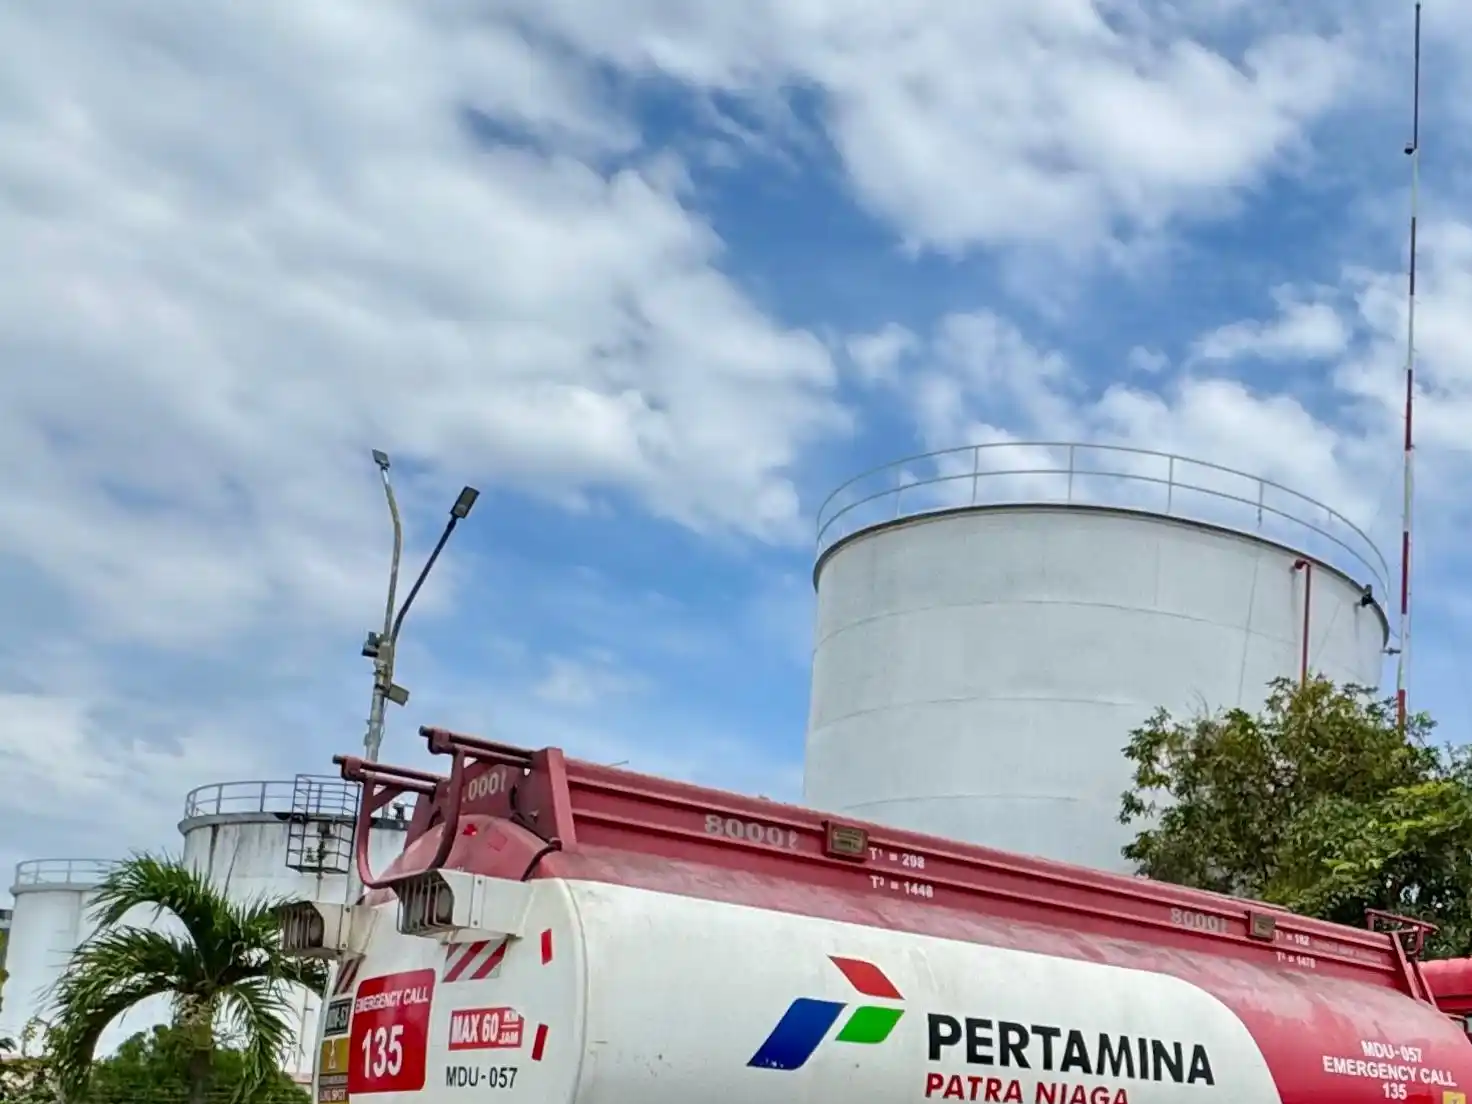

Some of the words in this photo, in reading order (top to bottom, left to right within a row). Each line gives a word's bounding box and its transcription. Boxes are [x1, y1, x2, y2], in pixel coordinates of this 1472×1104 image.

[403, 986, 428, 1005] CALL
[451, 1014, 480, 1044] MAX
[482, 1012, 499, 1042] 60
[362, 1025, 404, 1079] 135
[927, 1013, 1216, 1086] PERTAMINA
[1361, 1040, 1422, 1063] MDU-057
[1322, 1056, 1416, 1082] EMERGENCY
[1420, 1068, 1458, 1087] CALL
[925, 1073, 1024, 1104] PATRA
[1382, 1083, 1408, 1100] 135
